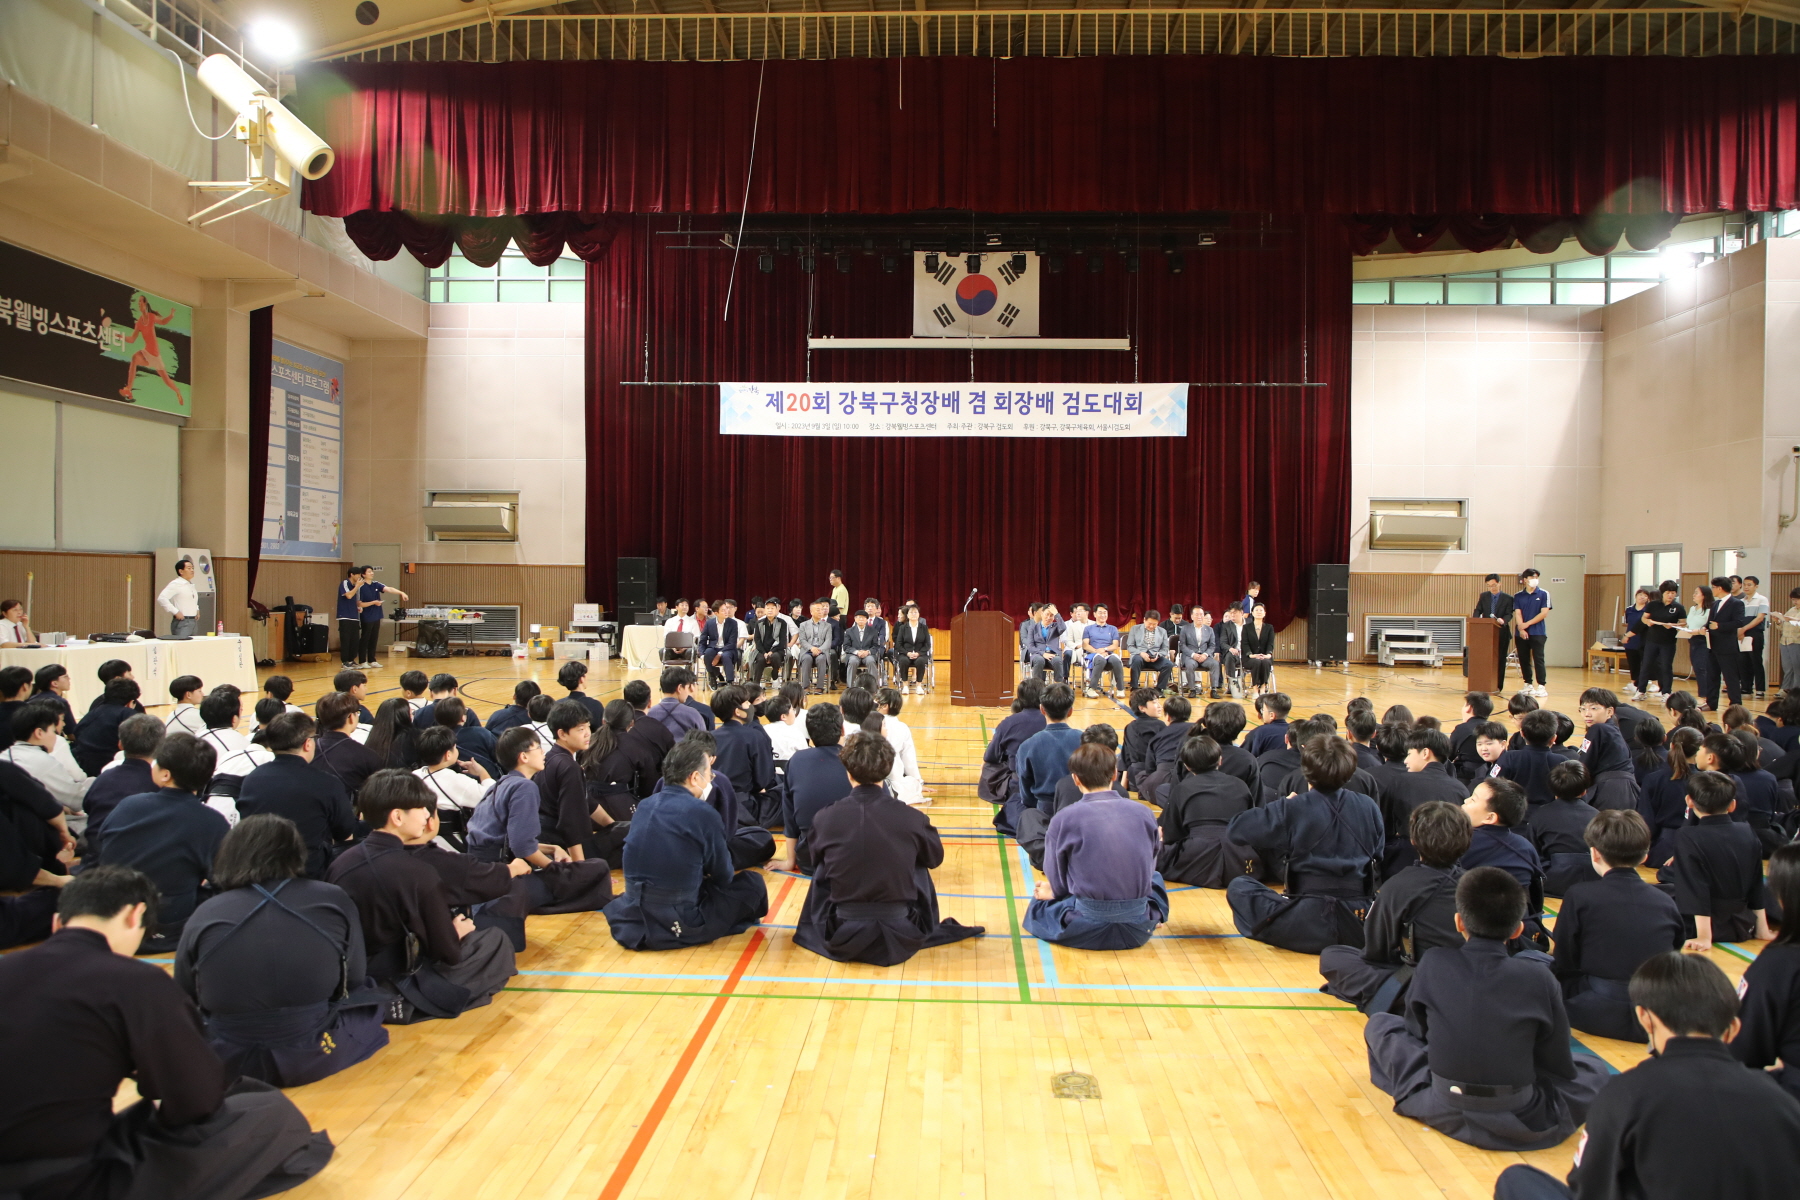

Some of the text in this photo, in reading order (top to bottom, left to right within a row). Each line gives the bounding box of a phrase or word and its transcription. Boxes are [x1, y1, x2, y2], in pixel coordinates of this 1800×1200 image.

[305, 374, 330, 395] 프로그램
[765, 391, 1143, 416] 제20회 강북구청장배 겸 회장배 검도대회
[791, 422, 811, 431] 2023년
